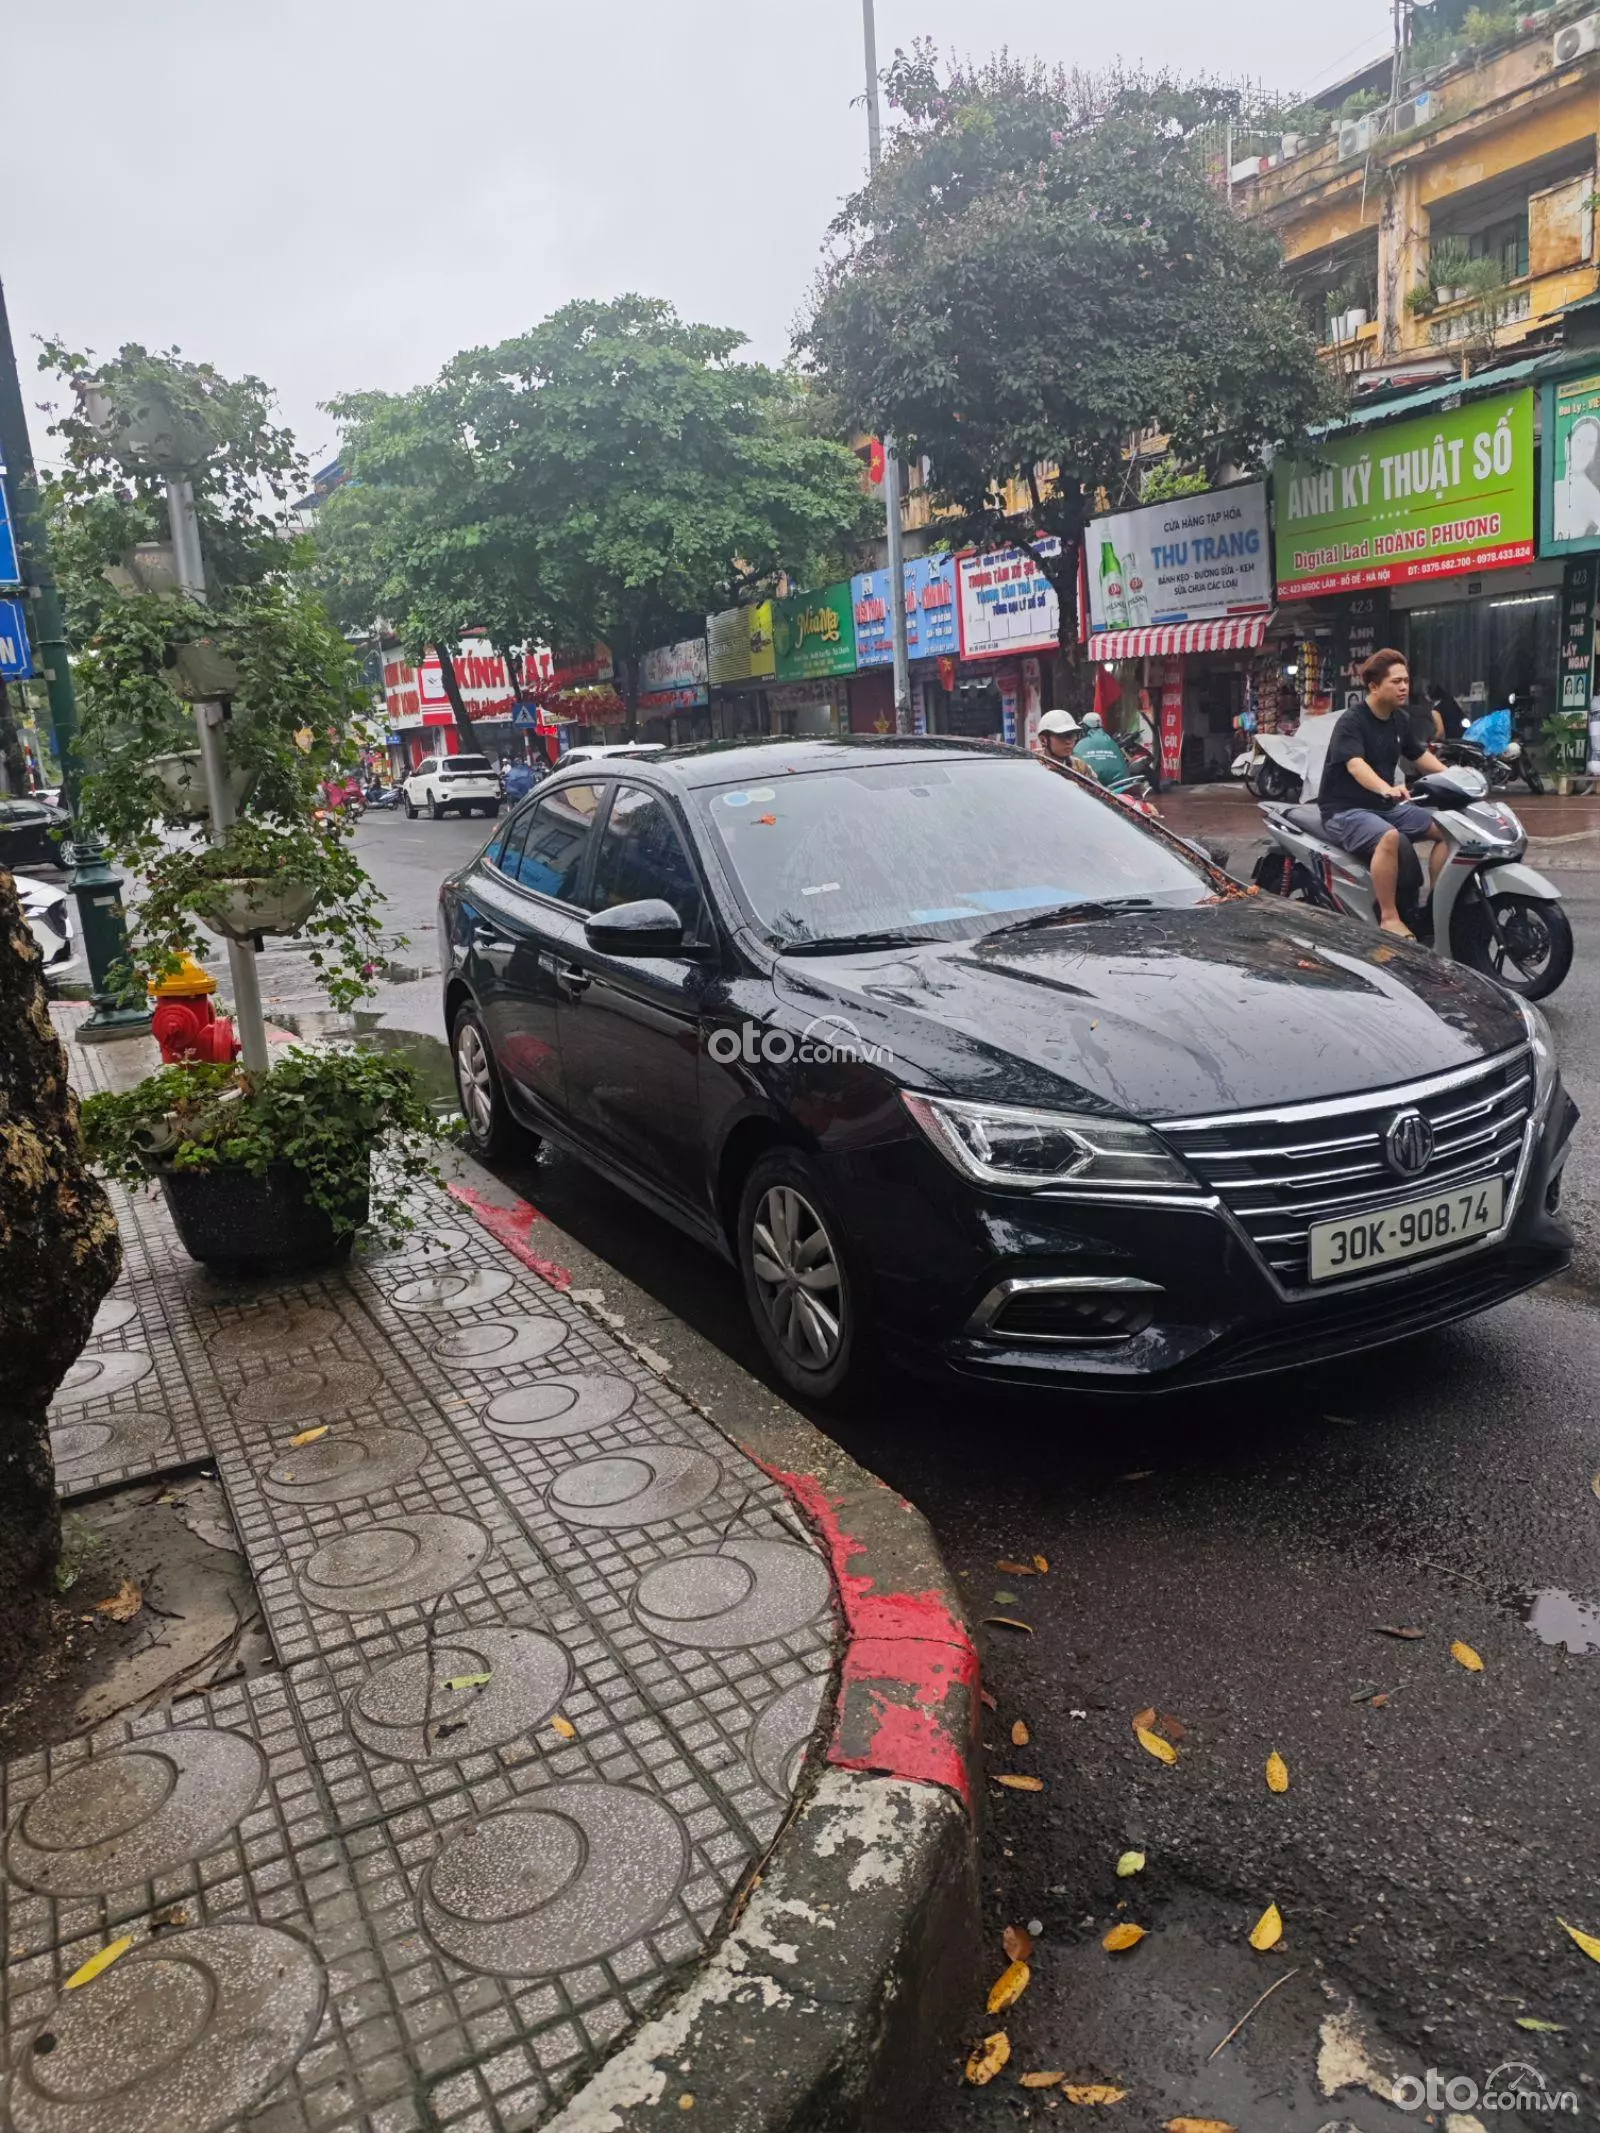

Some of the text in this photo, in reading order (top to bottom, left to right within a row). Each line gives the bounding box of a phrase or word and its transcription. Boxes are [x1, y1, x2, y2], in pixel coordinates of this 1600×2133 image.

[1341, 453, 1372, 509] KỸ
[1379, 433, 1464, 501] THUẬT
[1472, 407, 1514, 480] SỐ
[1182, 514, 1205, 528] HÀNG
[1206, 512, 1222, 527] TẠP
[1151, 529, 1260, 570] THU TRANG
[1293, 543, 1339, 571] Digital
[1374, 529, 1426, 557] HOÀNG
[1176, 573, 1190, 583] KẸO
[1207, 579, 1221, 591] CÁC
[453, 650, 505, 688] KÍNH
[1330, 1191, 1488, 1265] 30K-908.74
